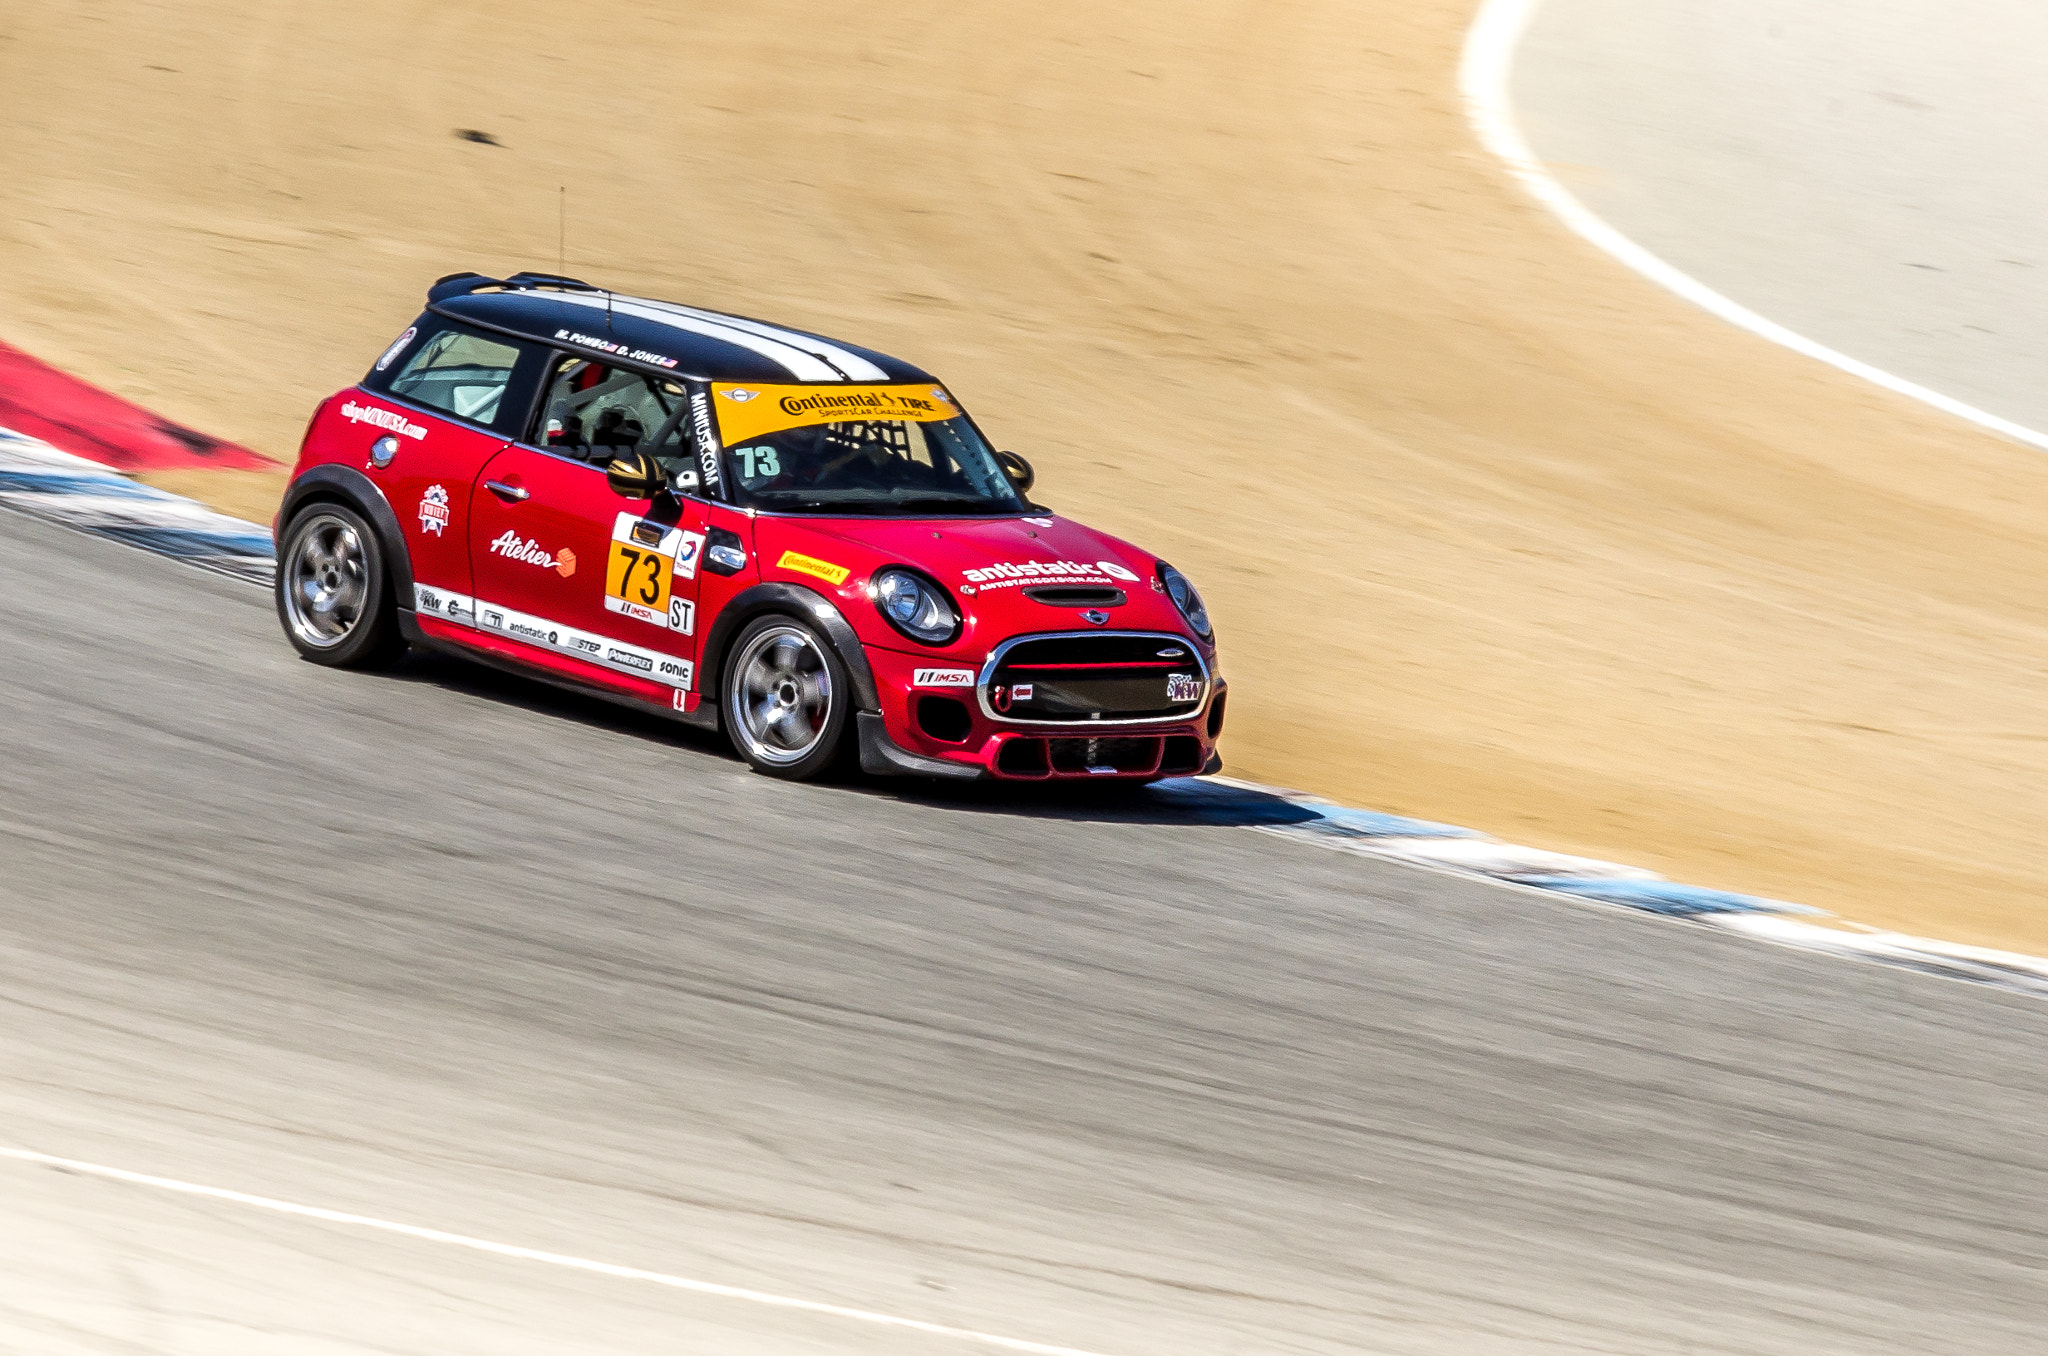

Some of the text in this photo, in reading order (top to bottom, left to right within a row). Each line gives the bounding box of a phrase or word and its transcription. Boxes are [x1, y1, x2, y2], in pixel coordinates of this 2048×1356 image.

[616, 345, 628, 356] D.
[779, 392, 936, 416] Continental TIRE
[691, 392, 719, 486] MINIUSA.COM
[735, 445, 781, 478] 73
[490, 529, 562, 568] Atelier
[620, 547, 661, 605] 73
[783, 554, 836, 576] Continental
[962, 560, 1101, 582] antistatic
[979, 576, 1113, 591] ANTISTATICDESIGN.COM
[671, 599, 692, 630] ST
[509, 622, 547, 640] antistatic
[578, 639, 602, 653] STEP
[659, 661, 689, 678] SONIC
[934, 673, 970, 683] IMSA
